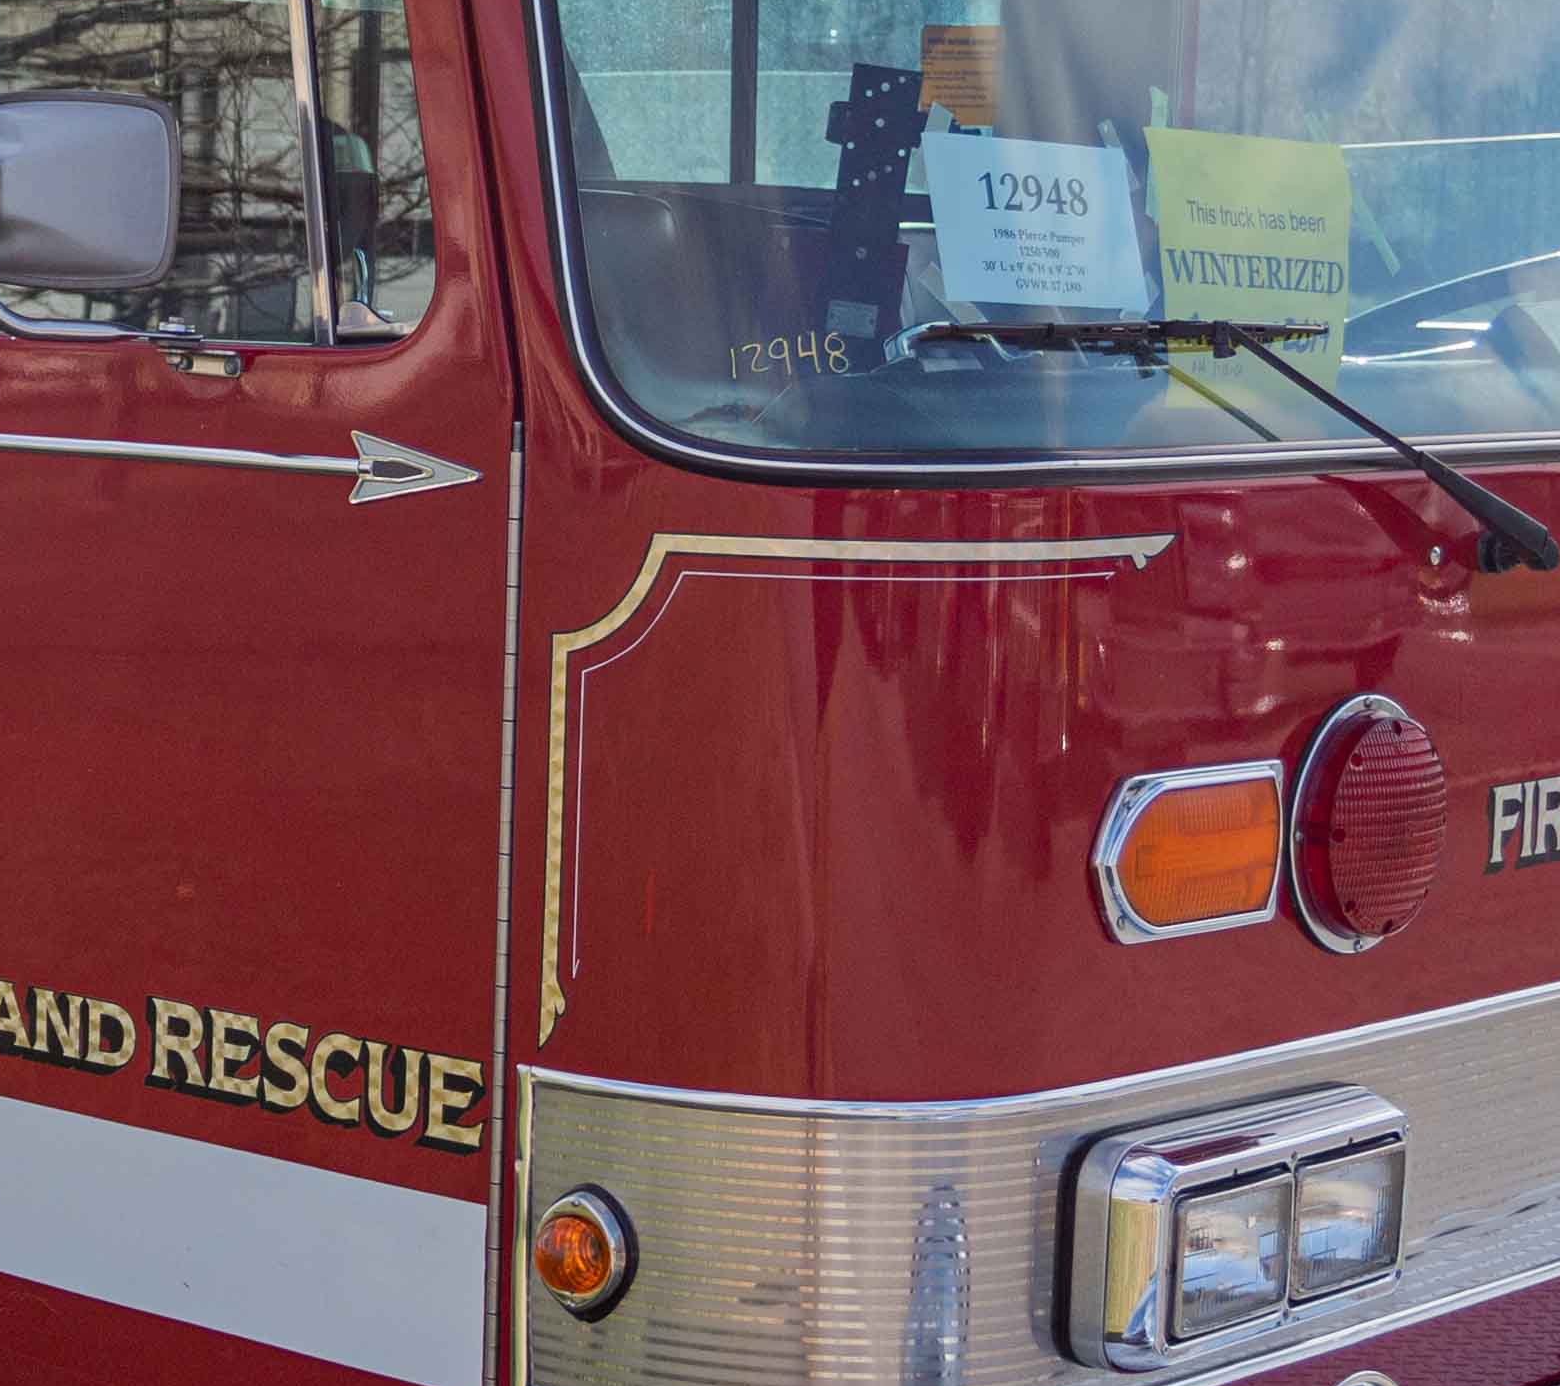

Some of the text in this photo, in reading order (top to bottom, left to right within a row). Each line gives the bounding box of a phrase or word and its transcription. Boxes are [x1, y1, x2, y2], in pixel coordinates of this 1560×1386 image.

[977, 171, 1089, 217] 12948
[1186, 199, 1327, 235] This truck has been
[992, 228, 1016, 240] 1986
[1018, 229, 1048, 242] Pierce
[1015, 278, 1048, 292] GVWR
[1165, 248, 1345, 294] WINTERIZED
[729, 330, 849, 380] 12948
[147, 995, 485, 1152] RESCUE
